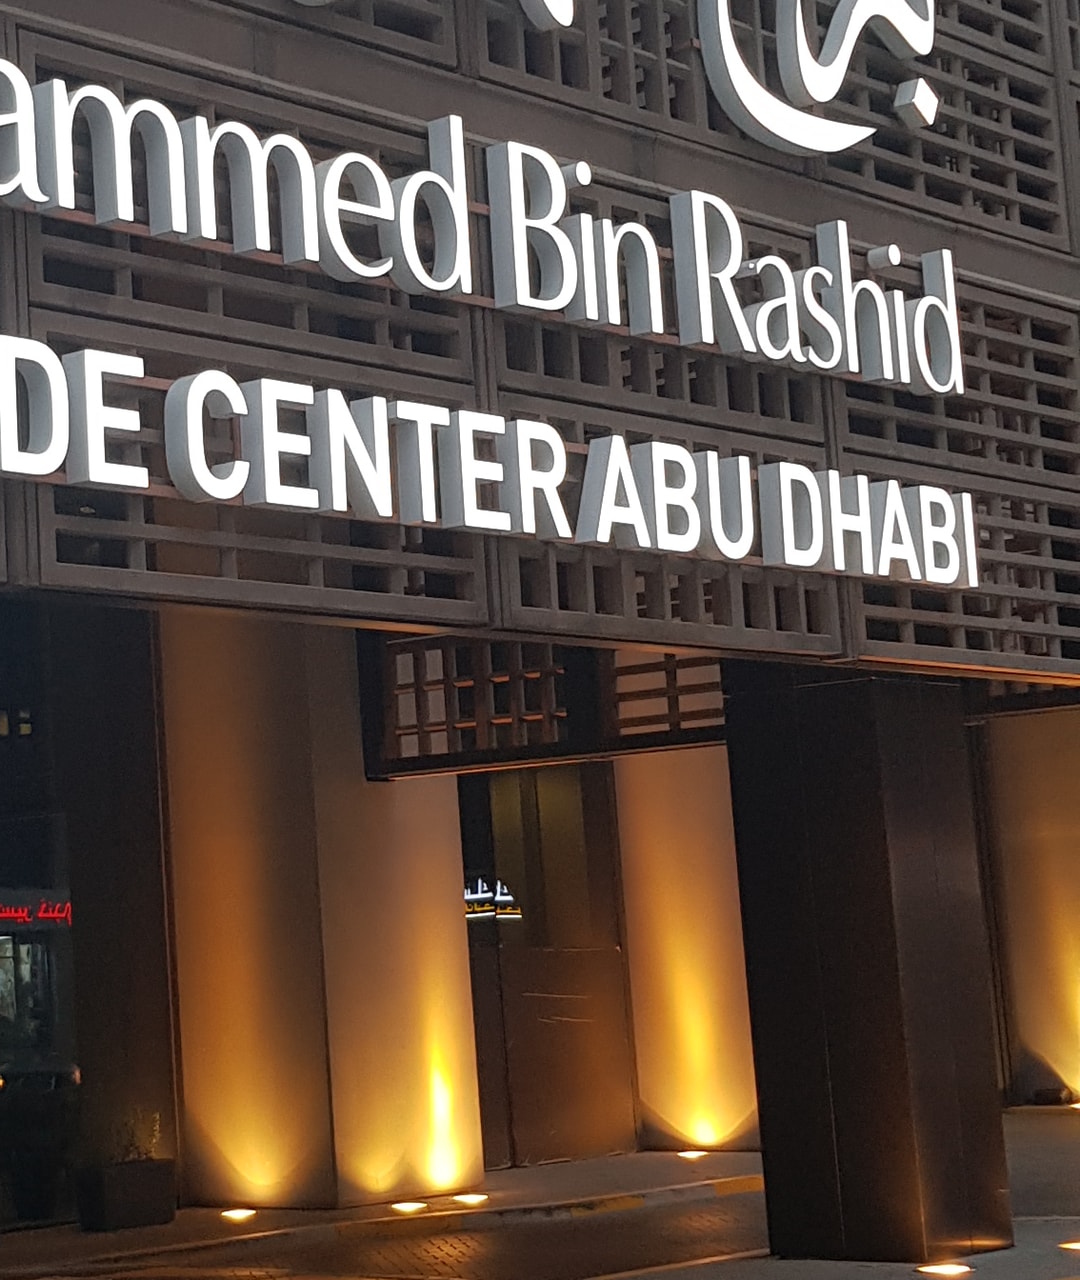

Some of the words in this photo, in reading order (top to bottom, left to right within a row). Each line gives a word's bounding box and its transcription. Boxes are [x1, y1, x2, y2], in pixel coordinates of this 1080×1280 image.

[493, 140, 665, 335] Bin
[670, 189, 964, 395] Rashid
[166, 368, 573, 540] CENTER
[575, 433, 755, 562] ABU
[759, 460, 980, 589] DHABI
